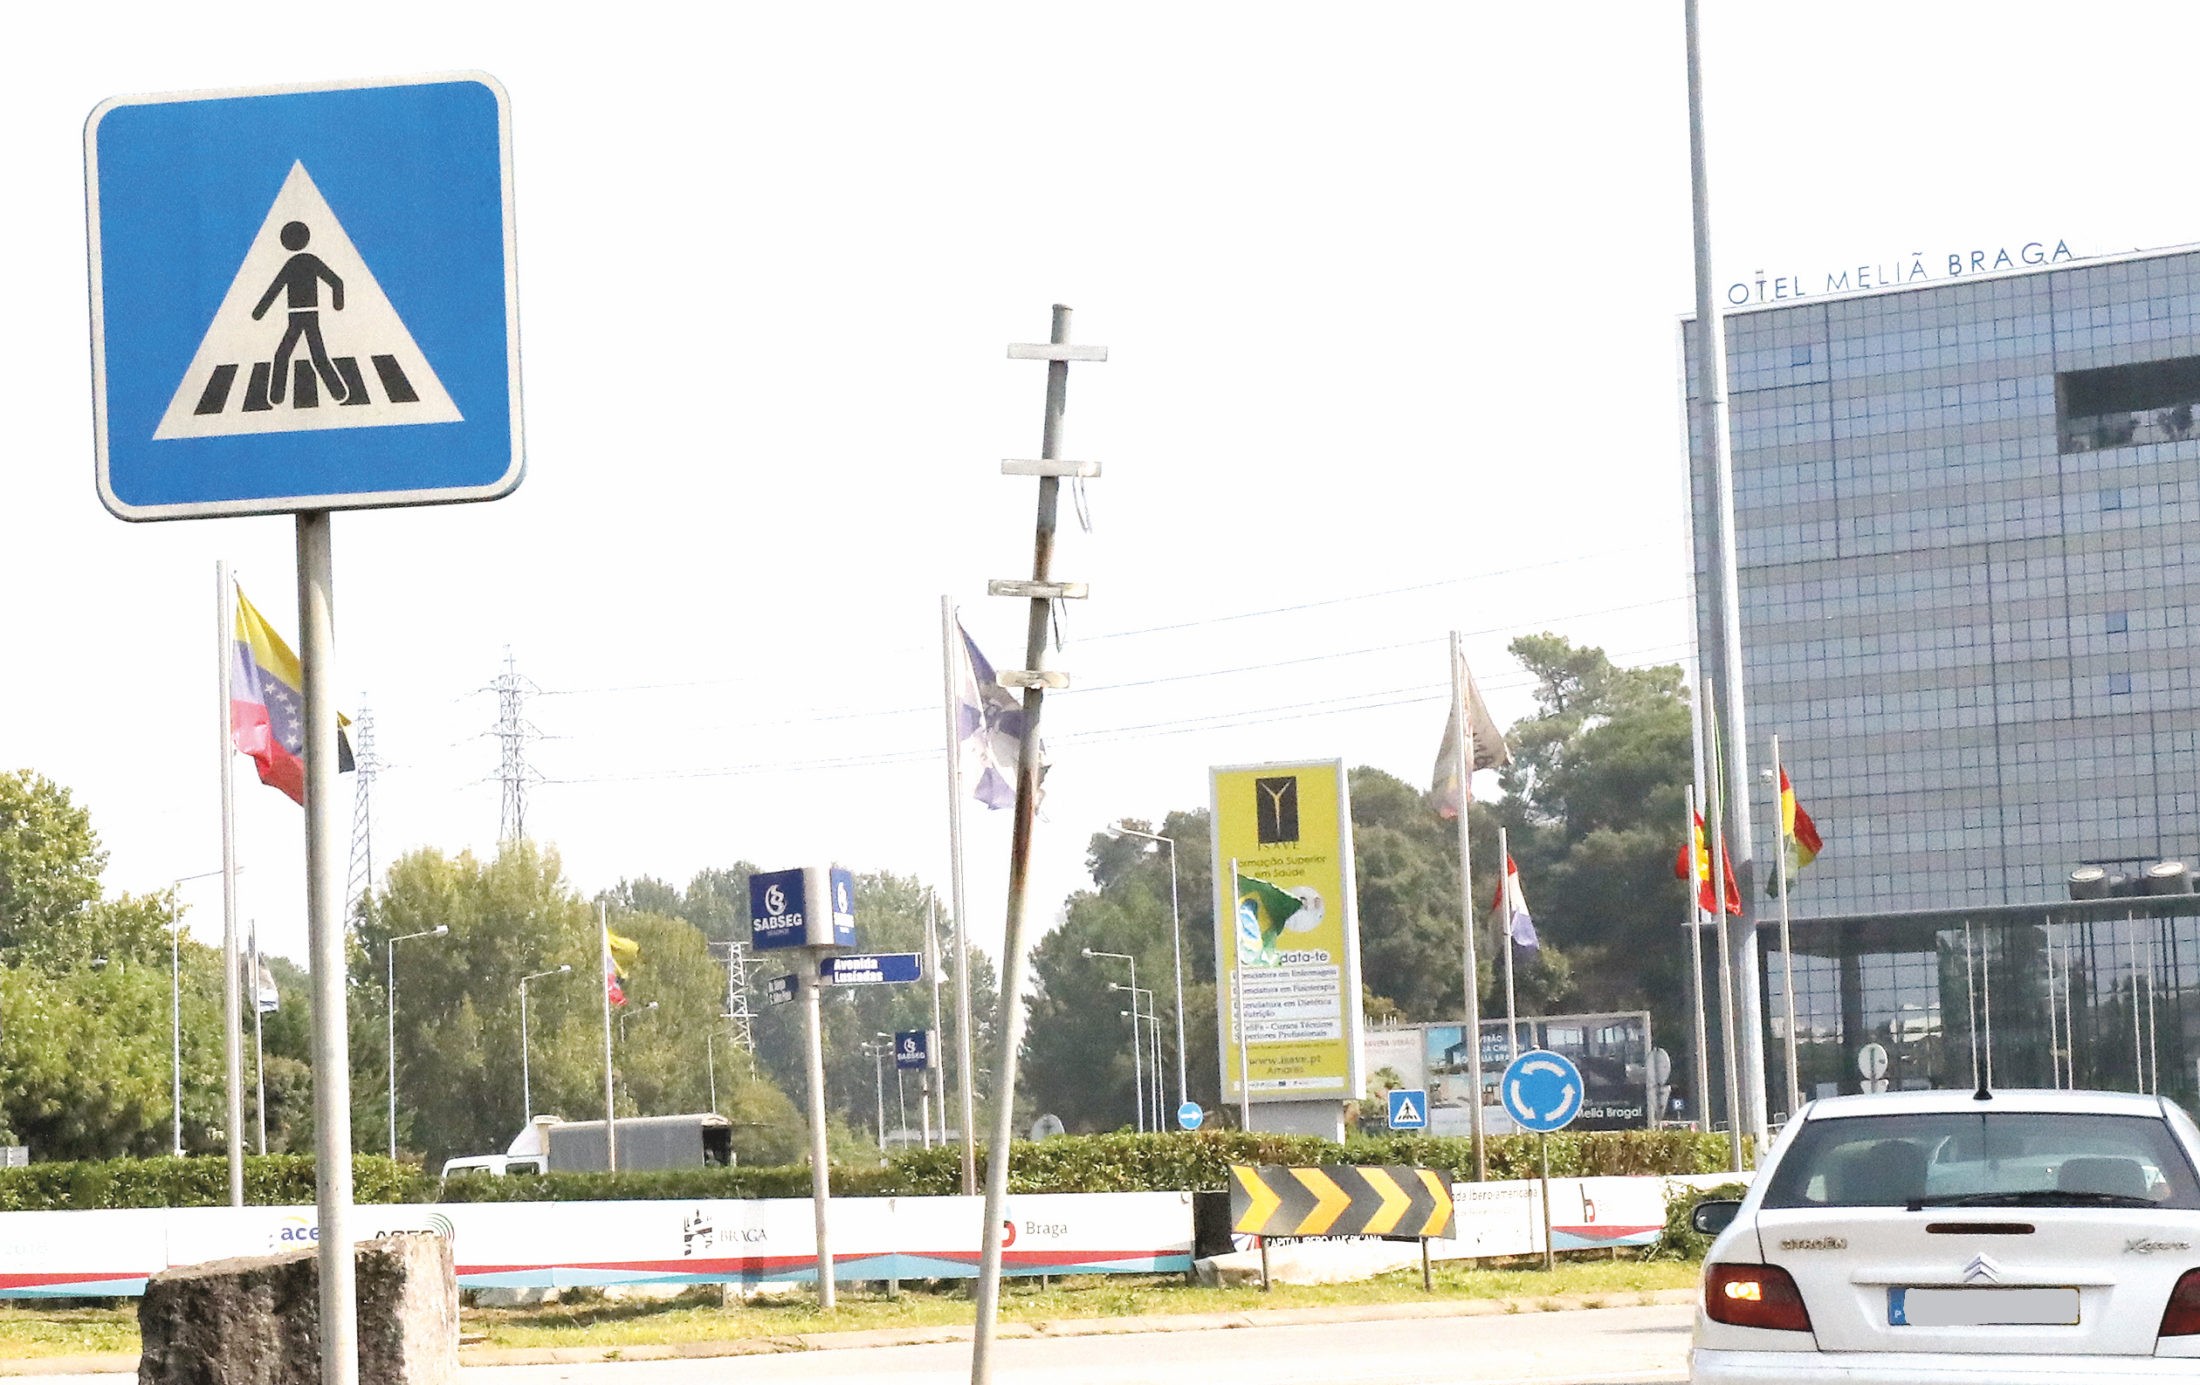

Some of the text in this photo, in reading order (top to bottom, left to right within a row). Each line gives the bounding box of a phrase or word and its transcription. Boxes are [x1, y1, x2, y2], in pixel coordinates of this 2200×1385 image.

[1948, 239, 2073, 277] BRAGA
[1229, 855, 1327, 867] ormação Superior
[1254, 871, 1271, 879] em
[753, 913, 803, 931] SABSEG
[1280, 951, 1328, 963] data-te
[834, 957, 878, 970] Avenida
[835, 970, 884, 983] Lusíadas
[1233, 971, 1277, 980] Lenciatura
[1233, 986, 1279, 994] Lenciatura
[1234, 1000, 1282, 1010] Lenciatura
[1235, 1032, 1276, 1040] Speriores
[720, 1227, 767, 1242] BRAGA
[1025, 1221, 1068, 1238] Braga
